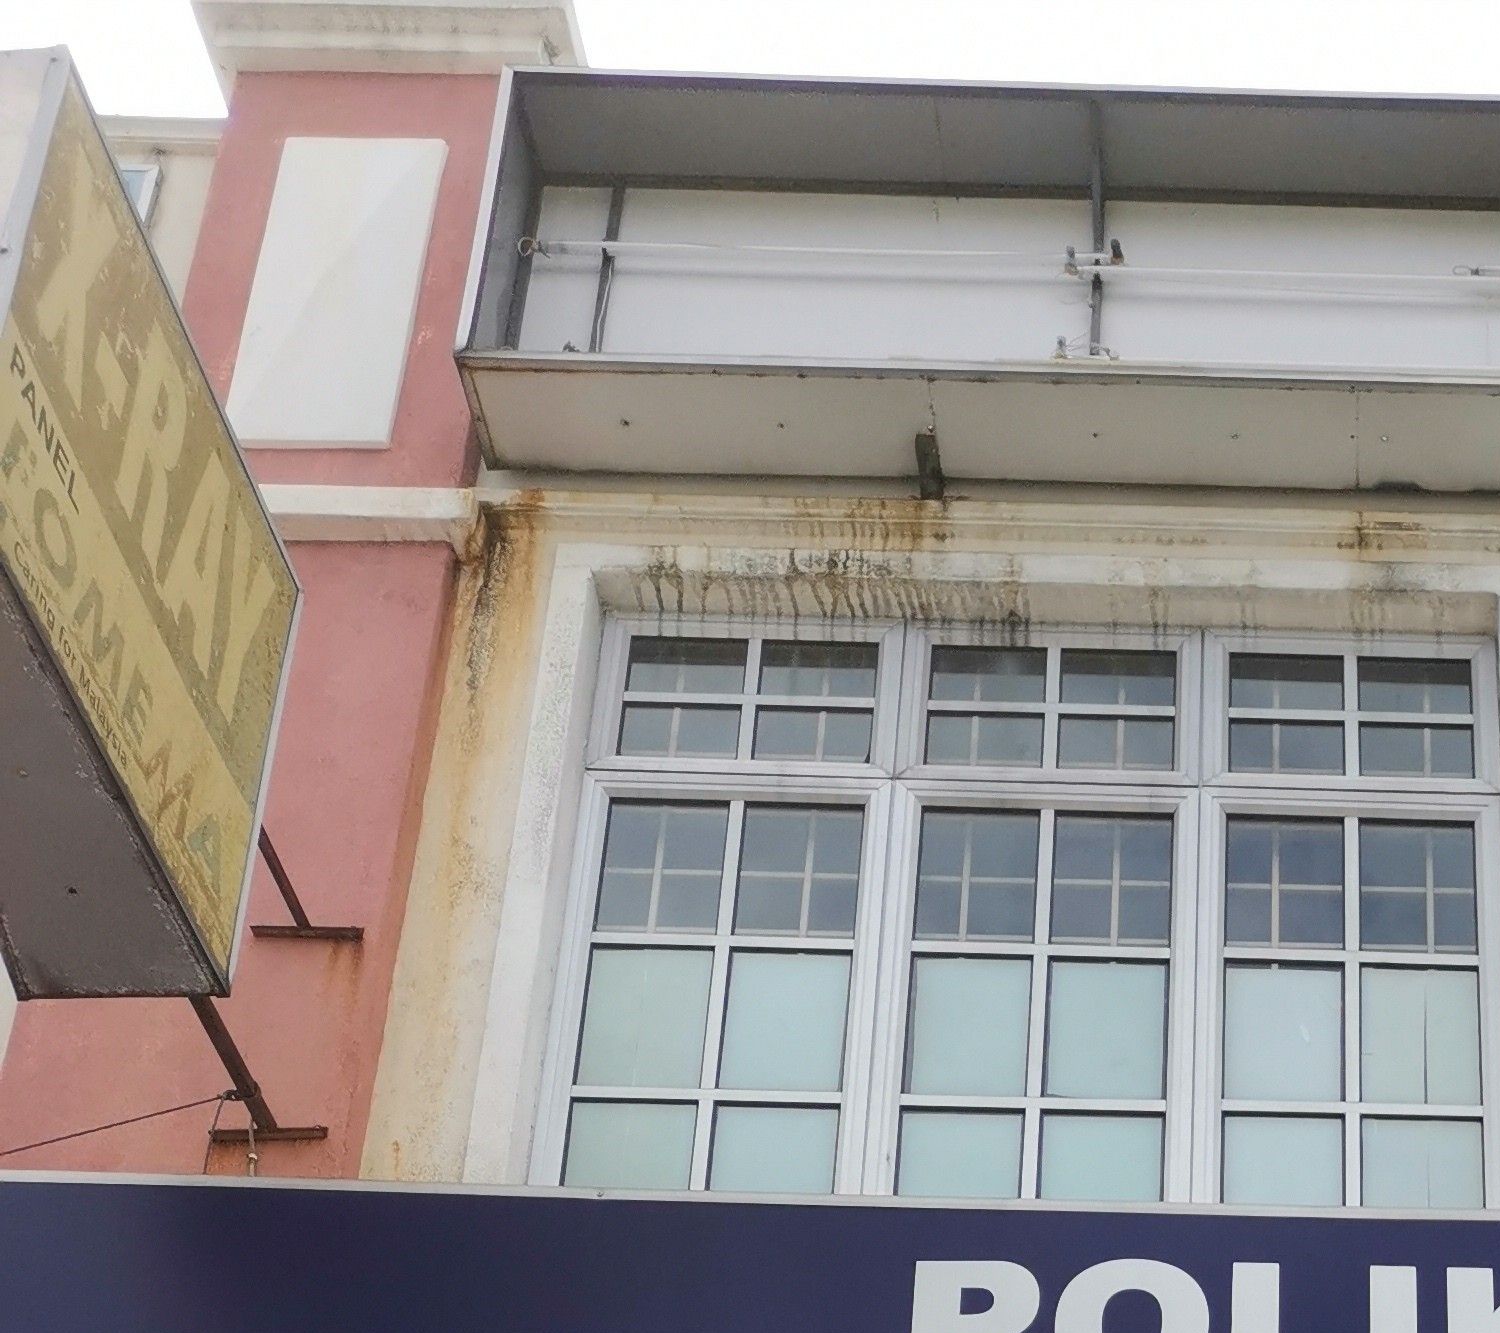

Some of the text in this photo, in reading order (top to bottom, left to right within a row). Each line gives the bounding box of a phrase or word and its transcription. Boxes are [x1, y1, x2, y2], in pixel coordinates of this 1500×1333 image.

[10, 344, 79, 516] PANEL
[13, 541, 57, 632] Caring
[58, 625, 77, 668] for
